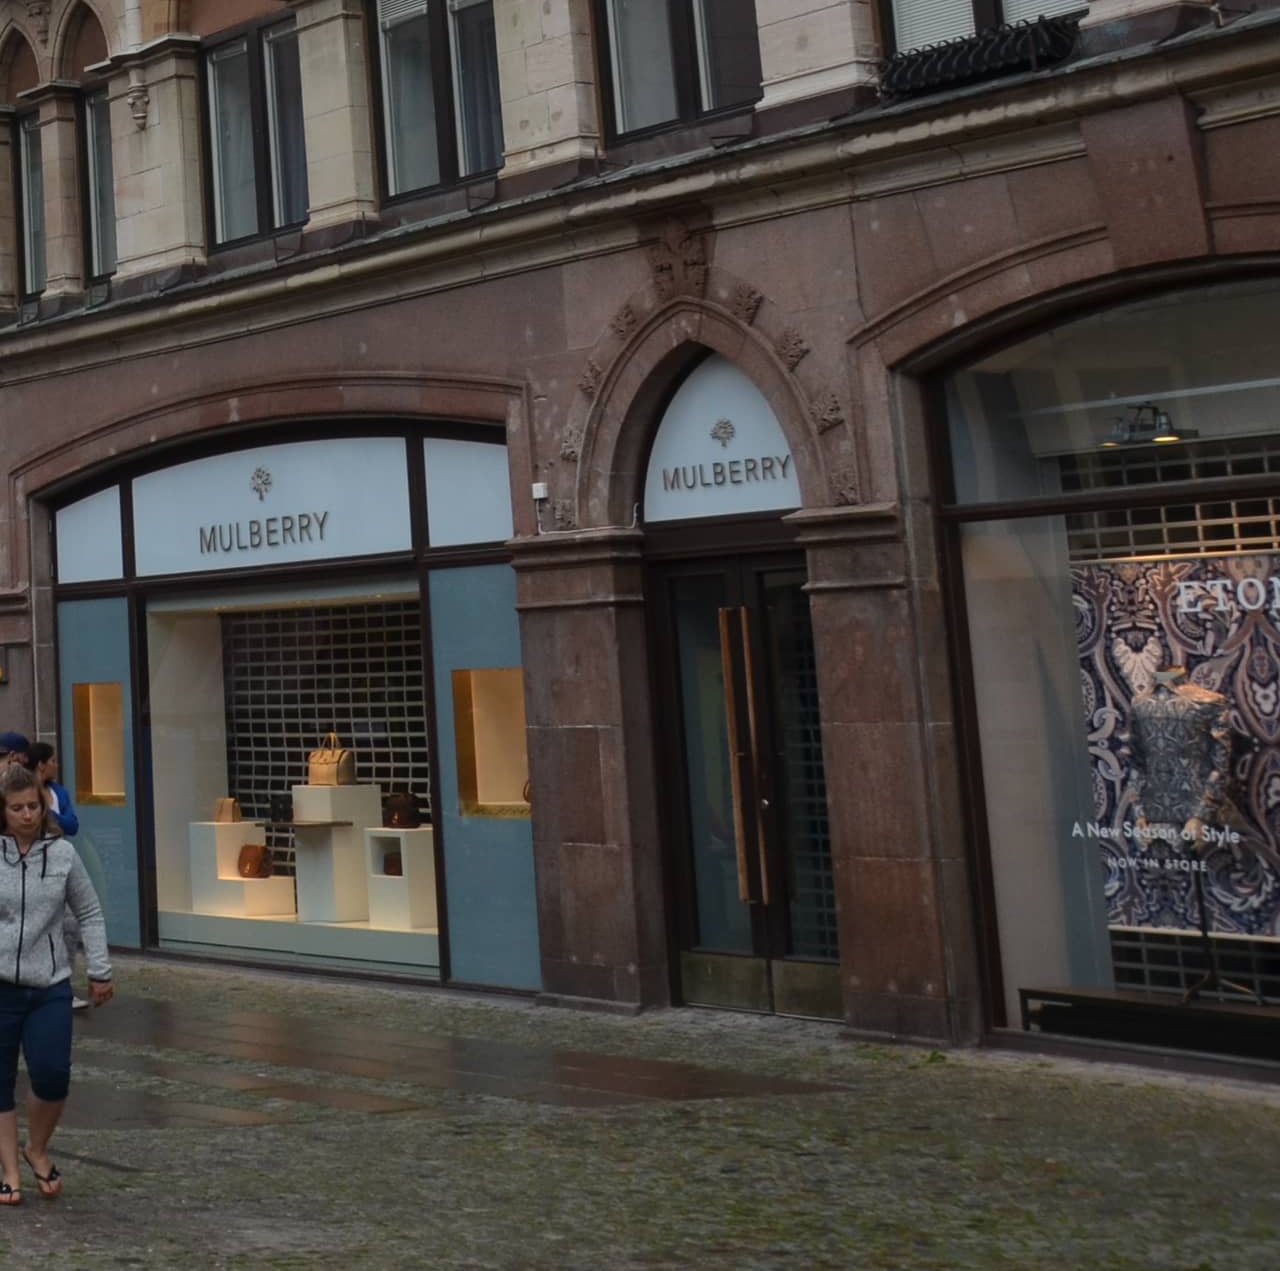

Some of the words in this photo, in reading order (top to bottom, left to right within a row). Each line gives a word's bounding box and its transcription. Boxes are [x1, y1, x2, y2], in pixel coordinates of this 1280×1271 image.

[662, 454, 790, 492] MULBERRY
[199, 511, 328, 554] MULBERRY
[1071, 821, 1085, 839] A
[1087, 822, 1120, 839] New
[1123, 822, 1178, 840] Season
[1181, 824, 1197, 842] of
[1201, 825, 1241, 847] Style
[1107, 857, 1138, 869] NOW
[1141, 858, 1159, 869] IN
[1163, 859, 1208, 872] STORE
